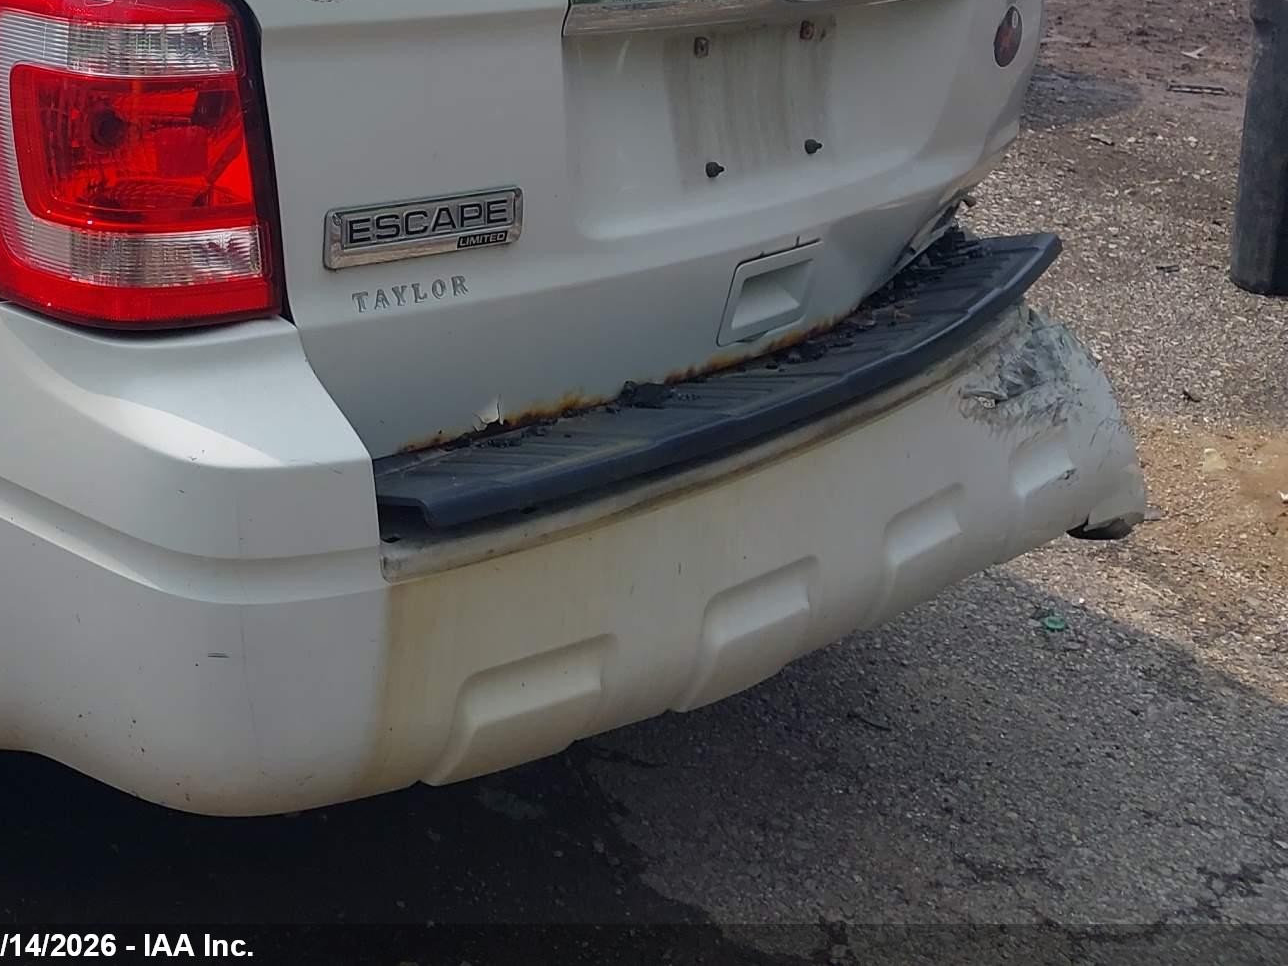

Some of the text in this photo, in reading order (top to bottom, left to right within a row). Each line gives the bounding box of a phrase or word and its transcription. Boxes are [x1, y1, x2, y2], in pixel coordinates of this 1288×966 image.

[348, 199, 509, 244] ESCAPE
[459, 232, 507, 248] LIMITED
[351, 275, 470, 314] TAYLOR
